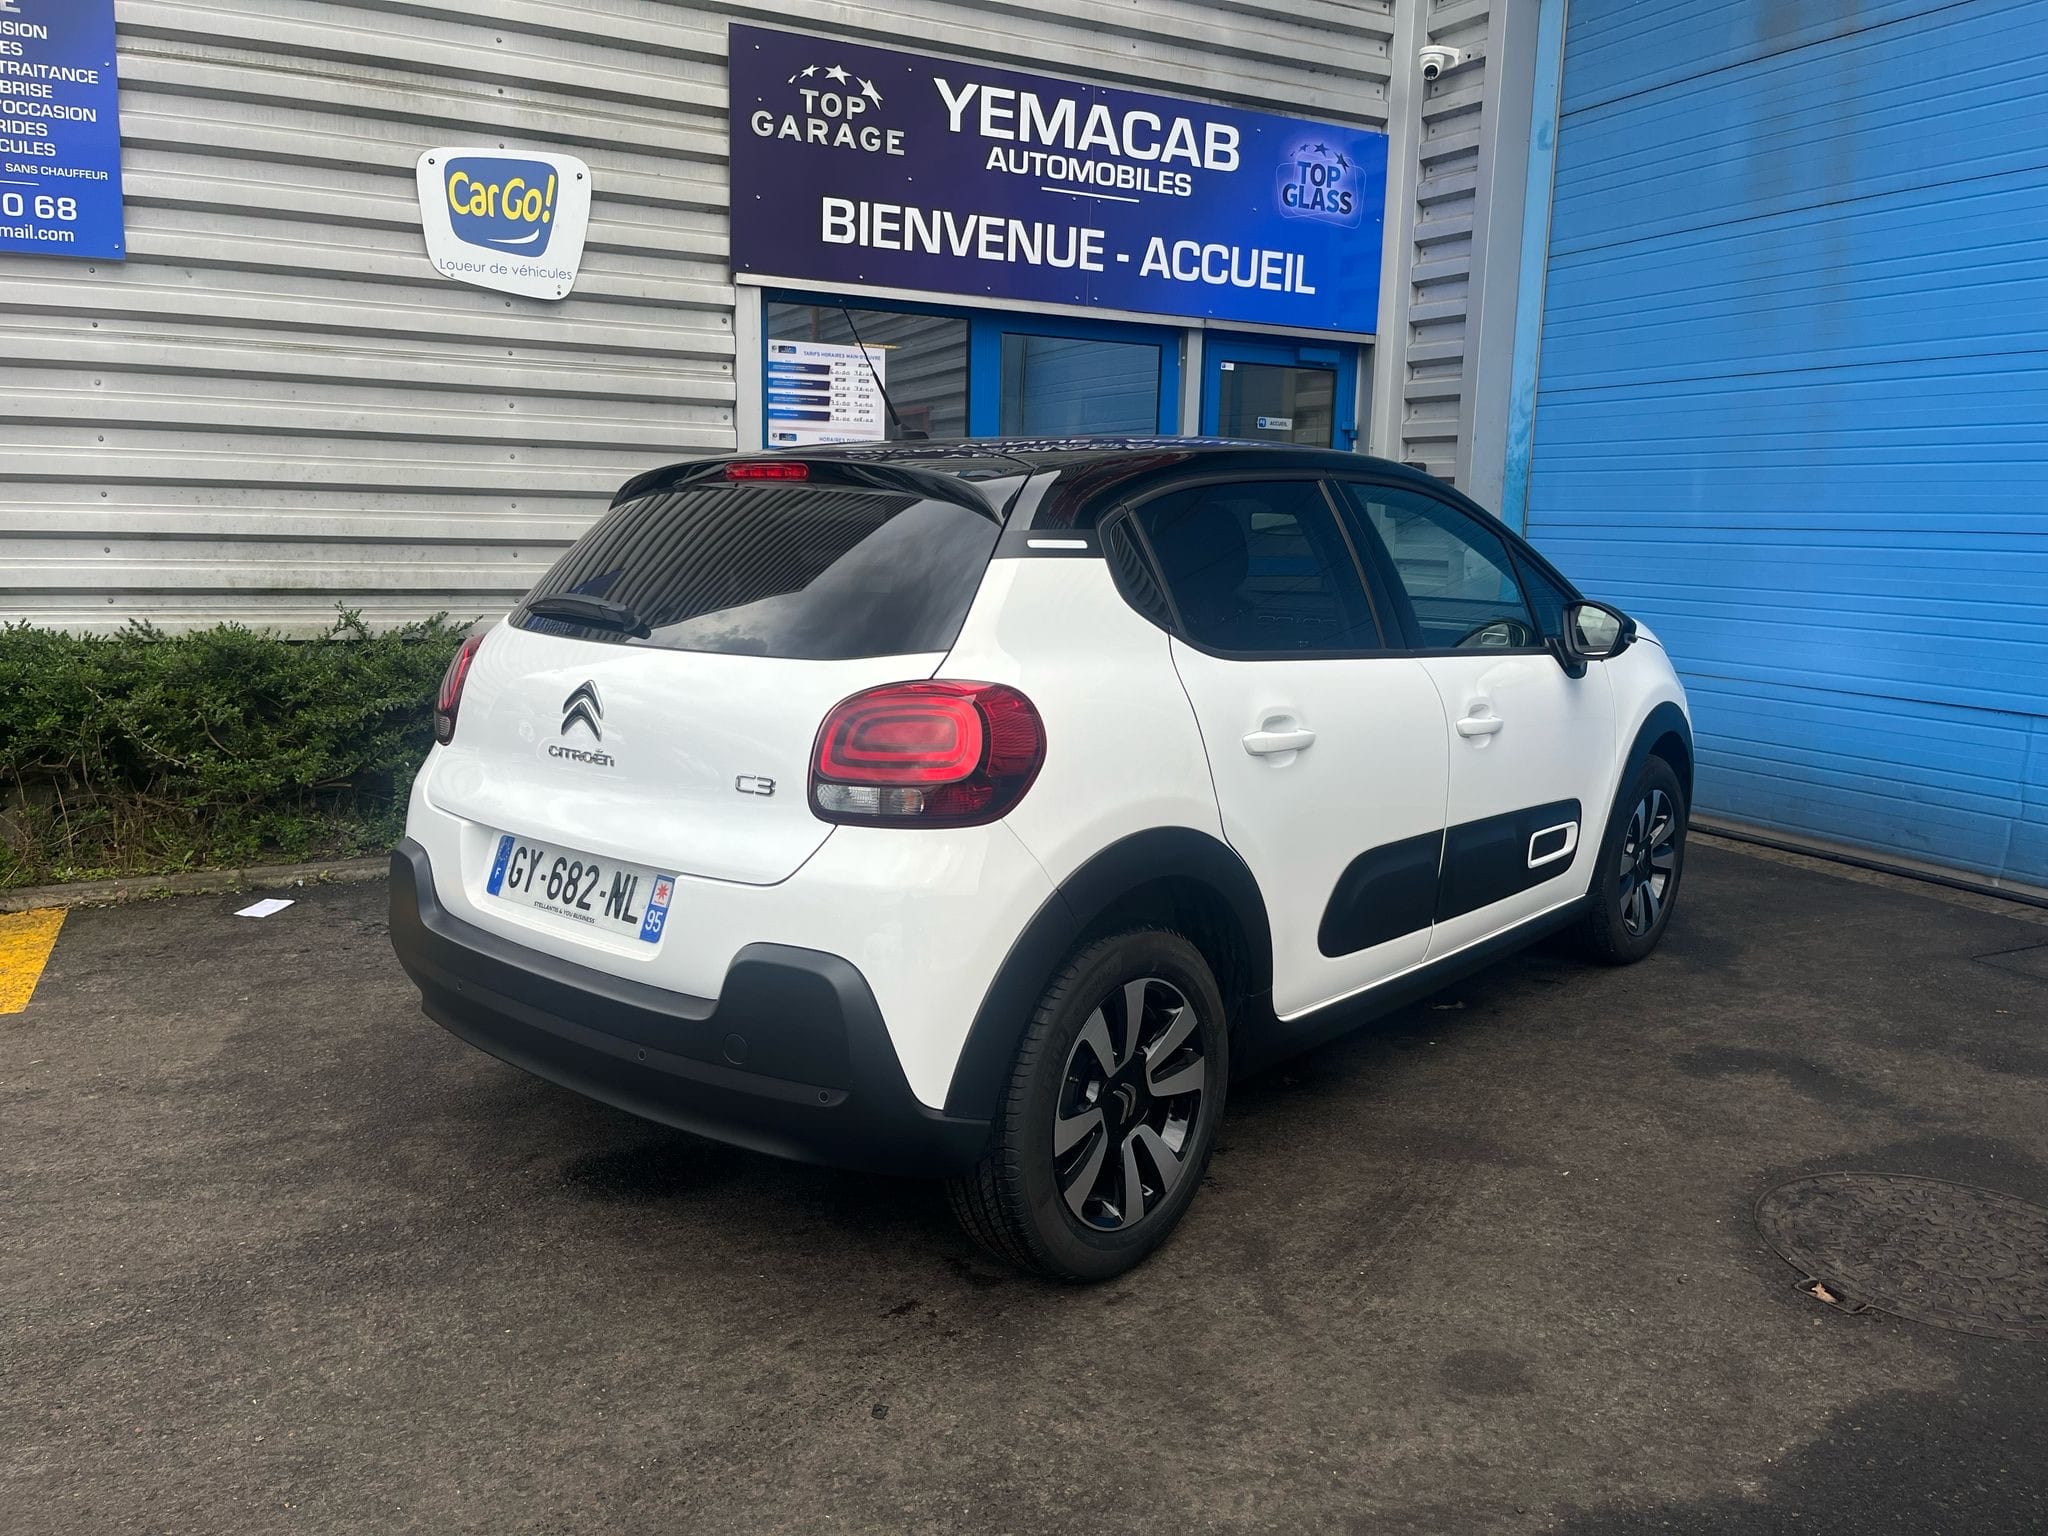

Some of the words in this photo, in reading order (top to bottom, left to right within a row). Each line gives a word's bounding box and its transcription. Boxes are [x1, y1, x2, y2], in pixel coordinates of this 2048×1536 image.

[799, 88, 866, 120] TOP
[751, 110, 905, 156] GARAGE
[933, 77, 1240, 172] YEMACAB
[5, 163, 38, 175] SANS
[40, 166, 109, 181] CHAUFFEUR
[986, 146, 1192, 197] AUTOMOBILES
[1297, 161, 1341, 188] TOP
[34, 195, 78, 221] 68
[1282, 183, 1352, 215] GLASS
[821, 197, 1105, 273] BIENVENUE
[1140, 236, 1316, 296] ACCUEIL
[439, 258, 486, 274] Loueur
[489, 262, 508, 276] de
[511, 265, 573, 281] véhicules
[735, 775, 777, 797] C3
[508, 846, 639, 925] GY-682-NL
[644, 909, 664, 933] 95
